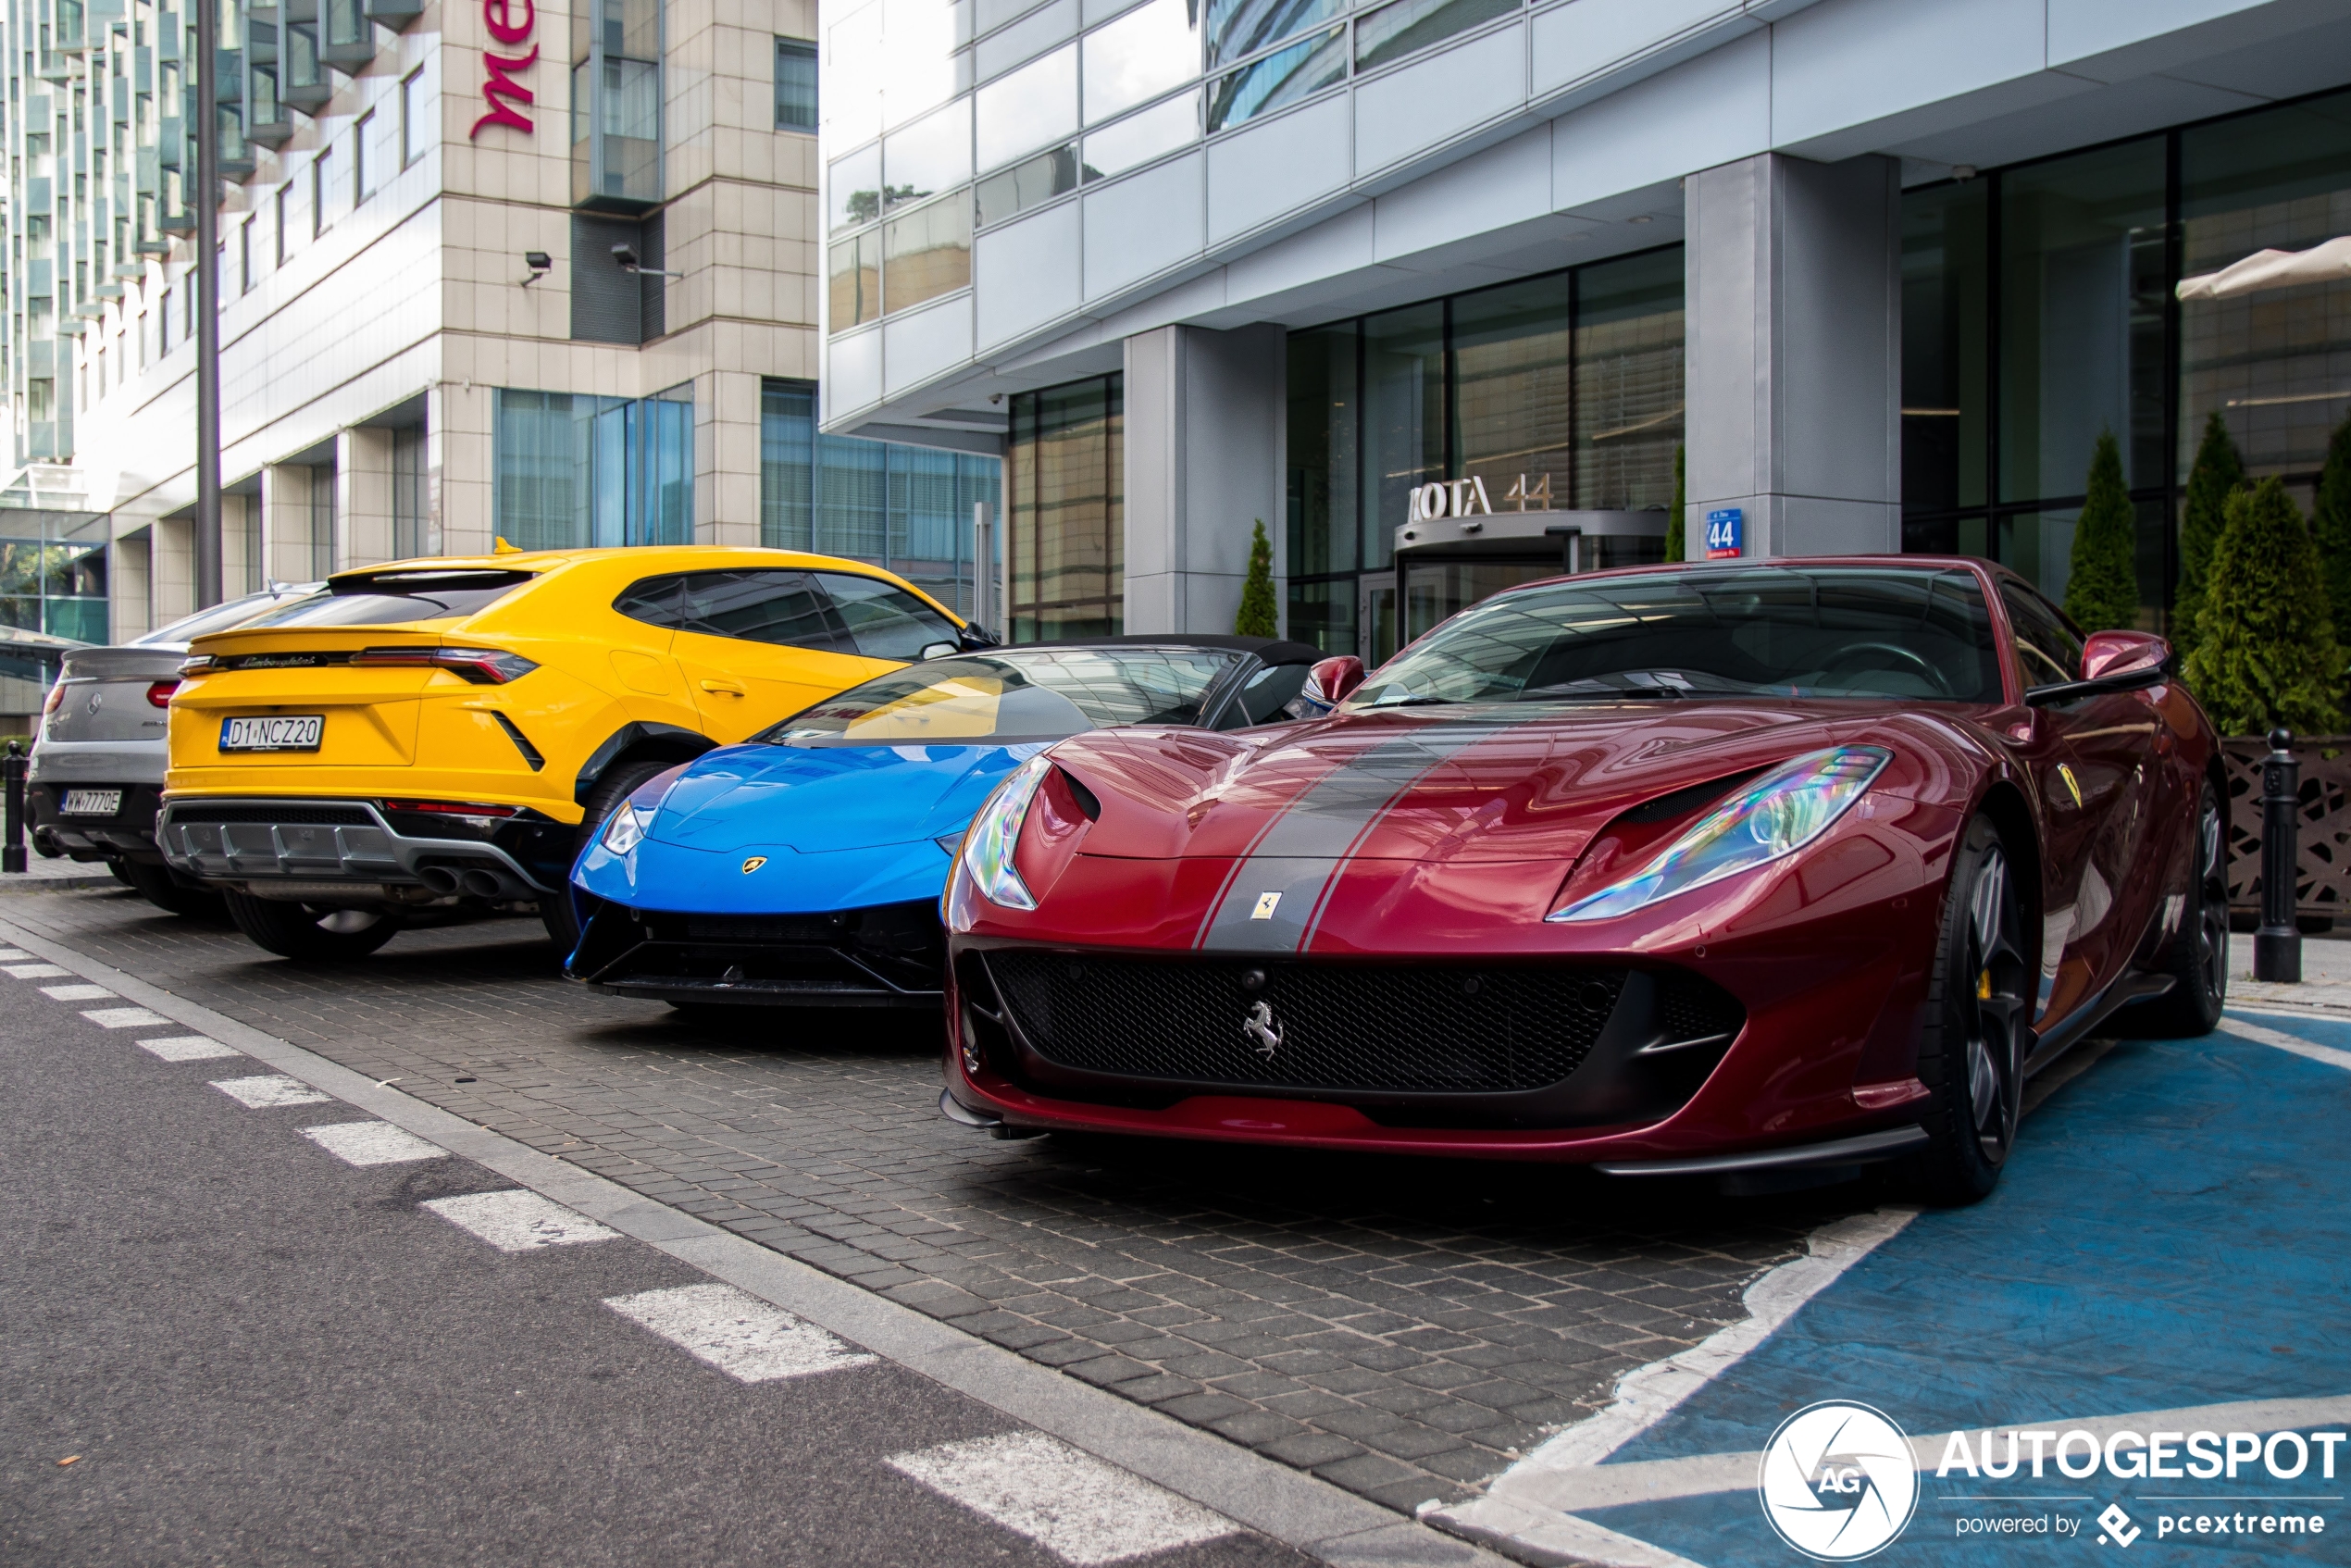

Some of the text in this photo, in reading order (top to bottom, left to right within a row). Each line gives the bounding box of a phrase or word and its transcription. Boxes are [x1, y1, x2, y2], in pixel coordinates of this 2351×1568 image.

[1503, 472, 1554, 512] 44
[1710, 521, 1734, 548] 44
[238, 655, 316, 667] Lamborghini
[231, 719, 317, 744] D1 NCZ20
[68, 791, 119, 811] WW 7770E
